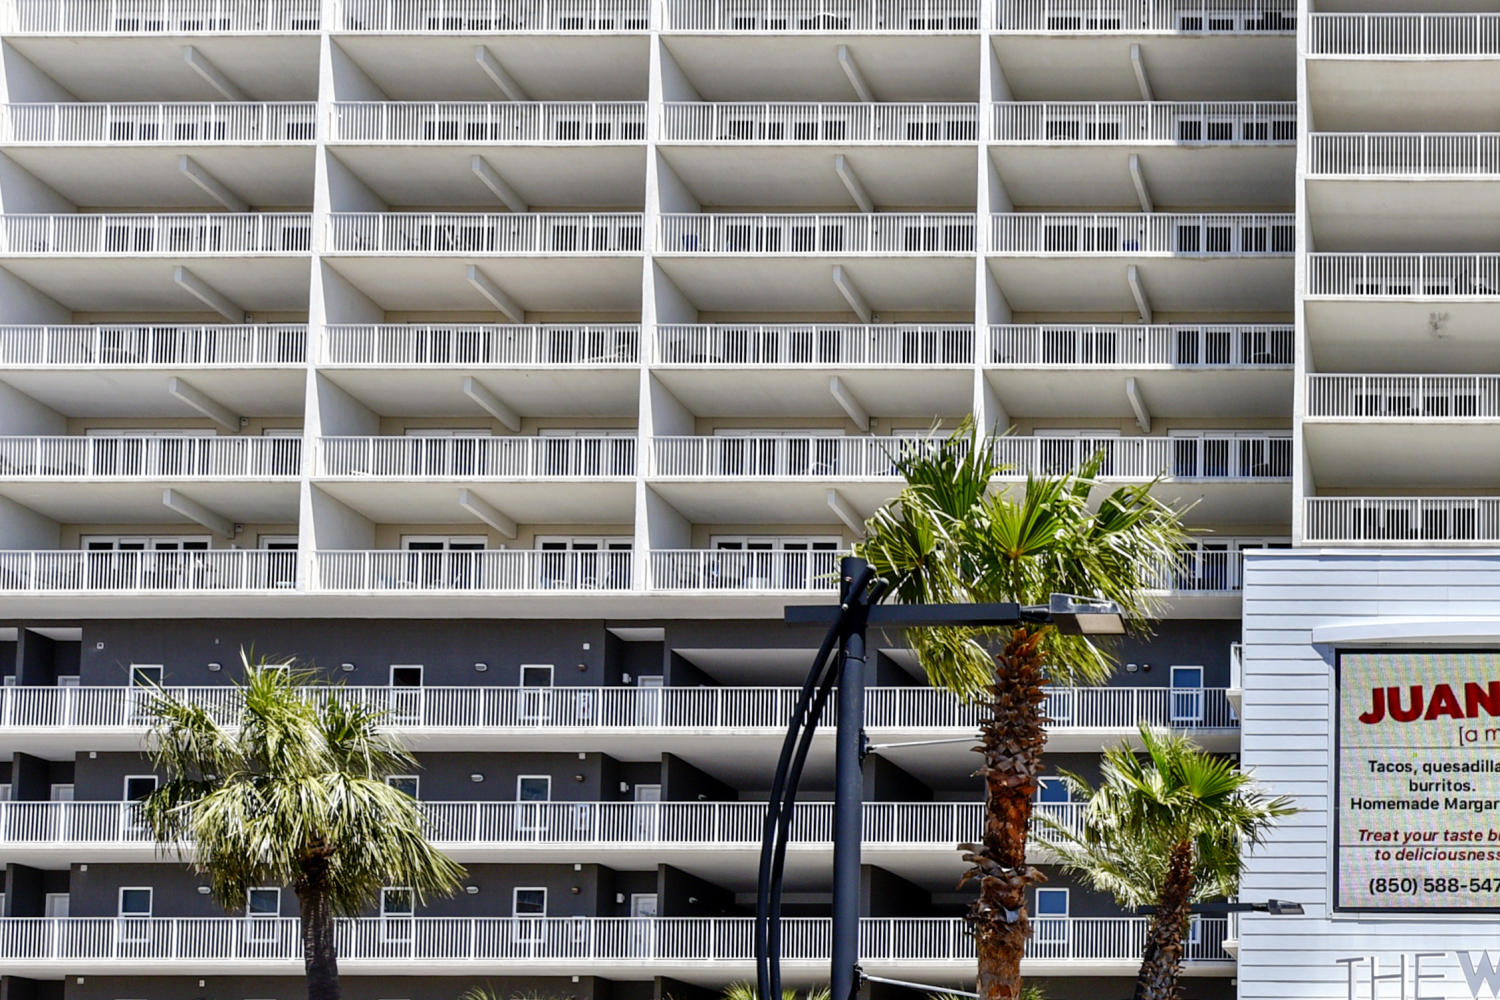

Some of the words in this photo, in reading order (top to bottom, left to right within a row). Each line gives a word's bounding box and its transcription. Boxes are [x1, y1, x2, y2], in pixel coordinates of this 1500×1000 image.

[1368, 760, 1418, 776] Tacos,
[1409, 778, 1477, 793] burritos.
[1350, 796, 1440, 811] Homemade
[1358, 829, 1400, 843] Treat
[1402, 830, 1439, 846] your
[1443, 829, 1483, 843] taste
[1374, 848, 1392, 862] to
[1368, 877, 1418, 896] (850)
